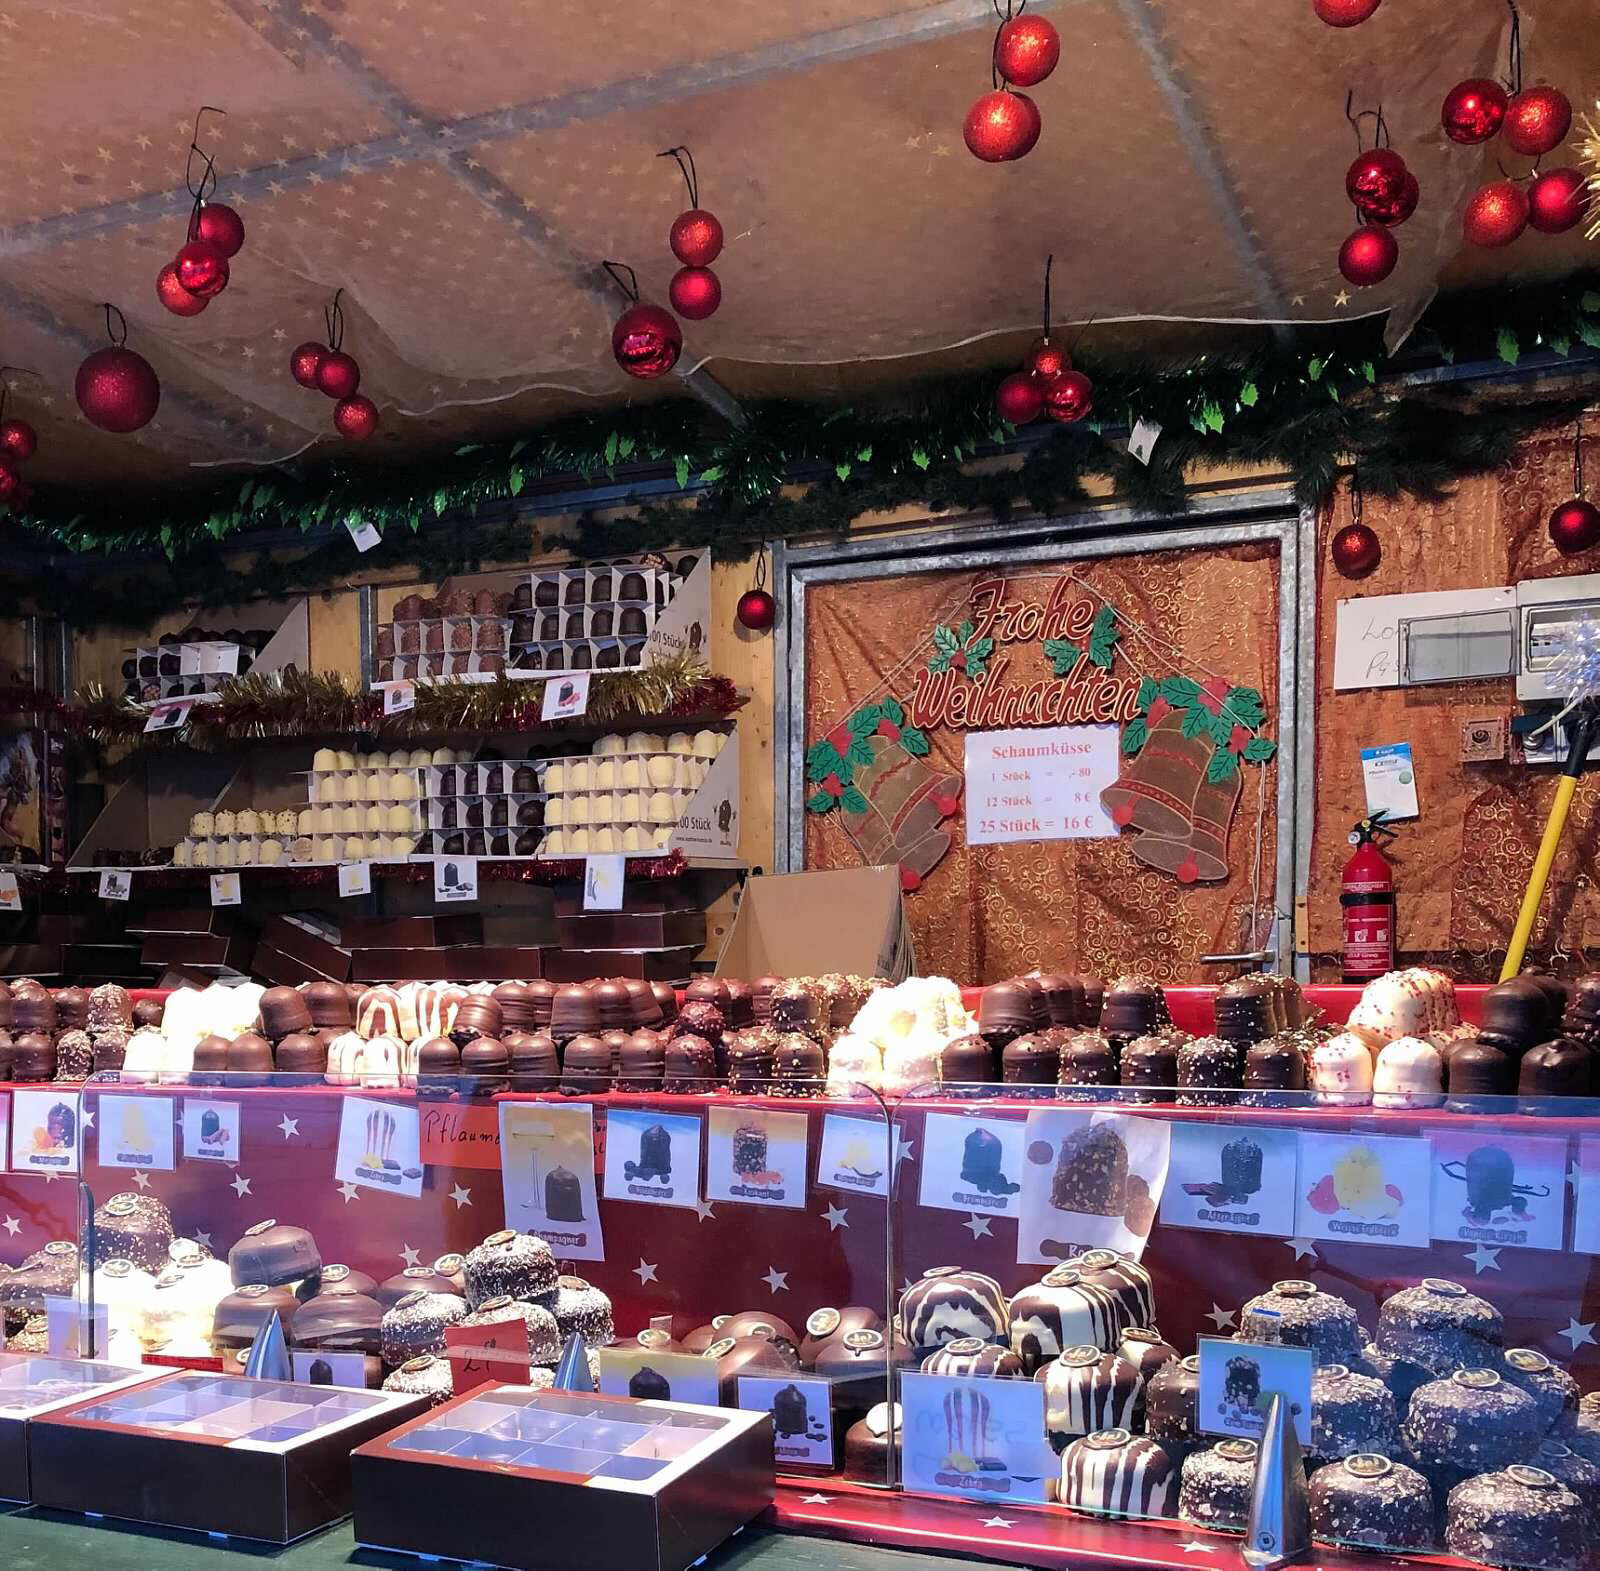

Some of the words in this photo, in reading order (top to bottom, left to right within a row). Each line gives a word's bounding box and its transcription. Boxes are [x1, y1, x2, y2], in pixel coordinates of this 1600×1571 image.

[966, 576, 1095, 647] Frohe
[1361, 616, 1399, 640] Lo
[663, 631, 682, 649] Stück
[911, 653, 1143, 729] Weihnachten
[991, 743, 1092, 760] Schaumküsse
[991, 772, 996, 782] 1
[1001, 770, 1031, 781] Stück
[986, 797, 997, 807] 12
[1000, 795, 1032, 807] Stück
[1074, 793, 1081, 802] 8
[1084, 792, 1092, 802] €
[691, 816, 711, 831] Stück
[979, 820, 996, 833] 25
[999, 818, 1041, 832] Stück
[1063, 816, 1080, 829] 16
[1084, 815, 1095, 829] €
